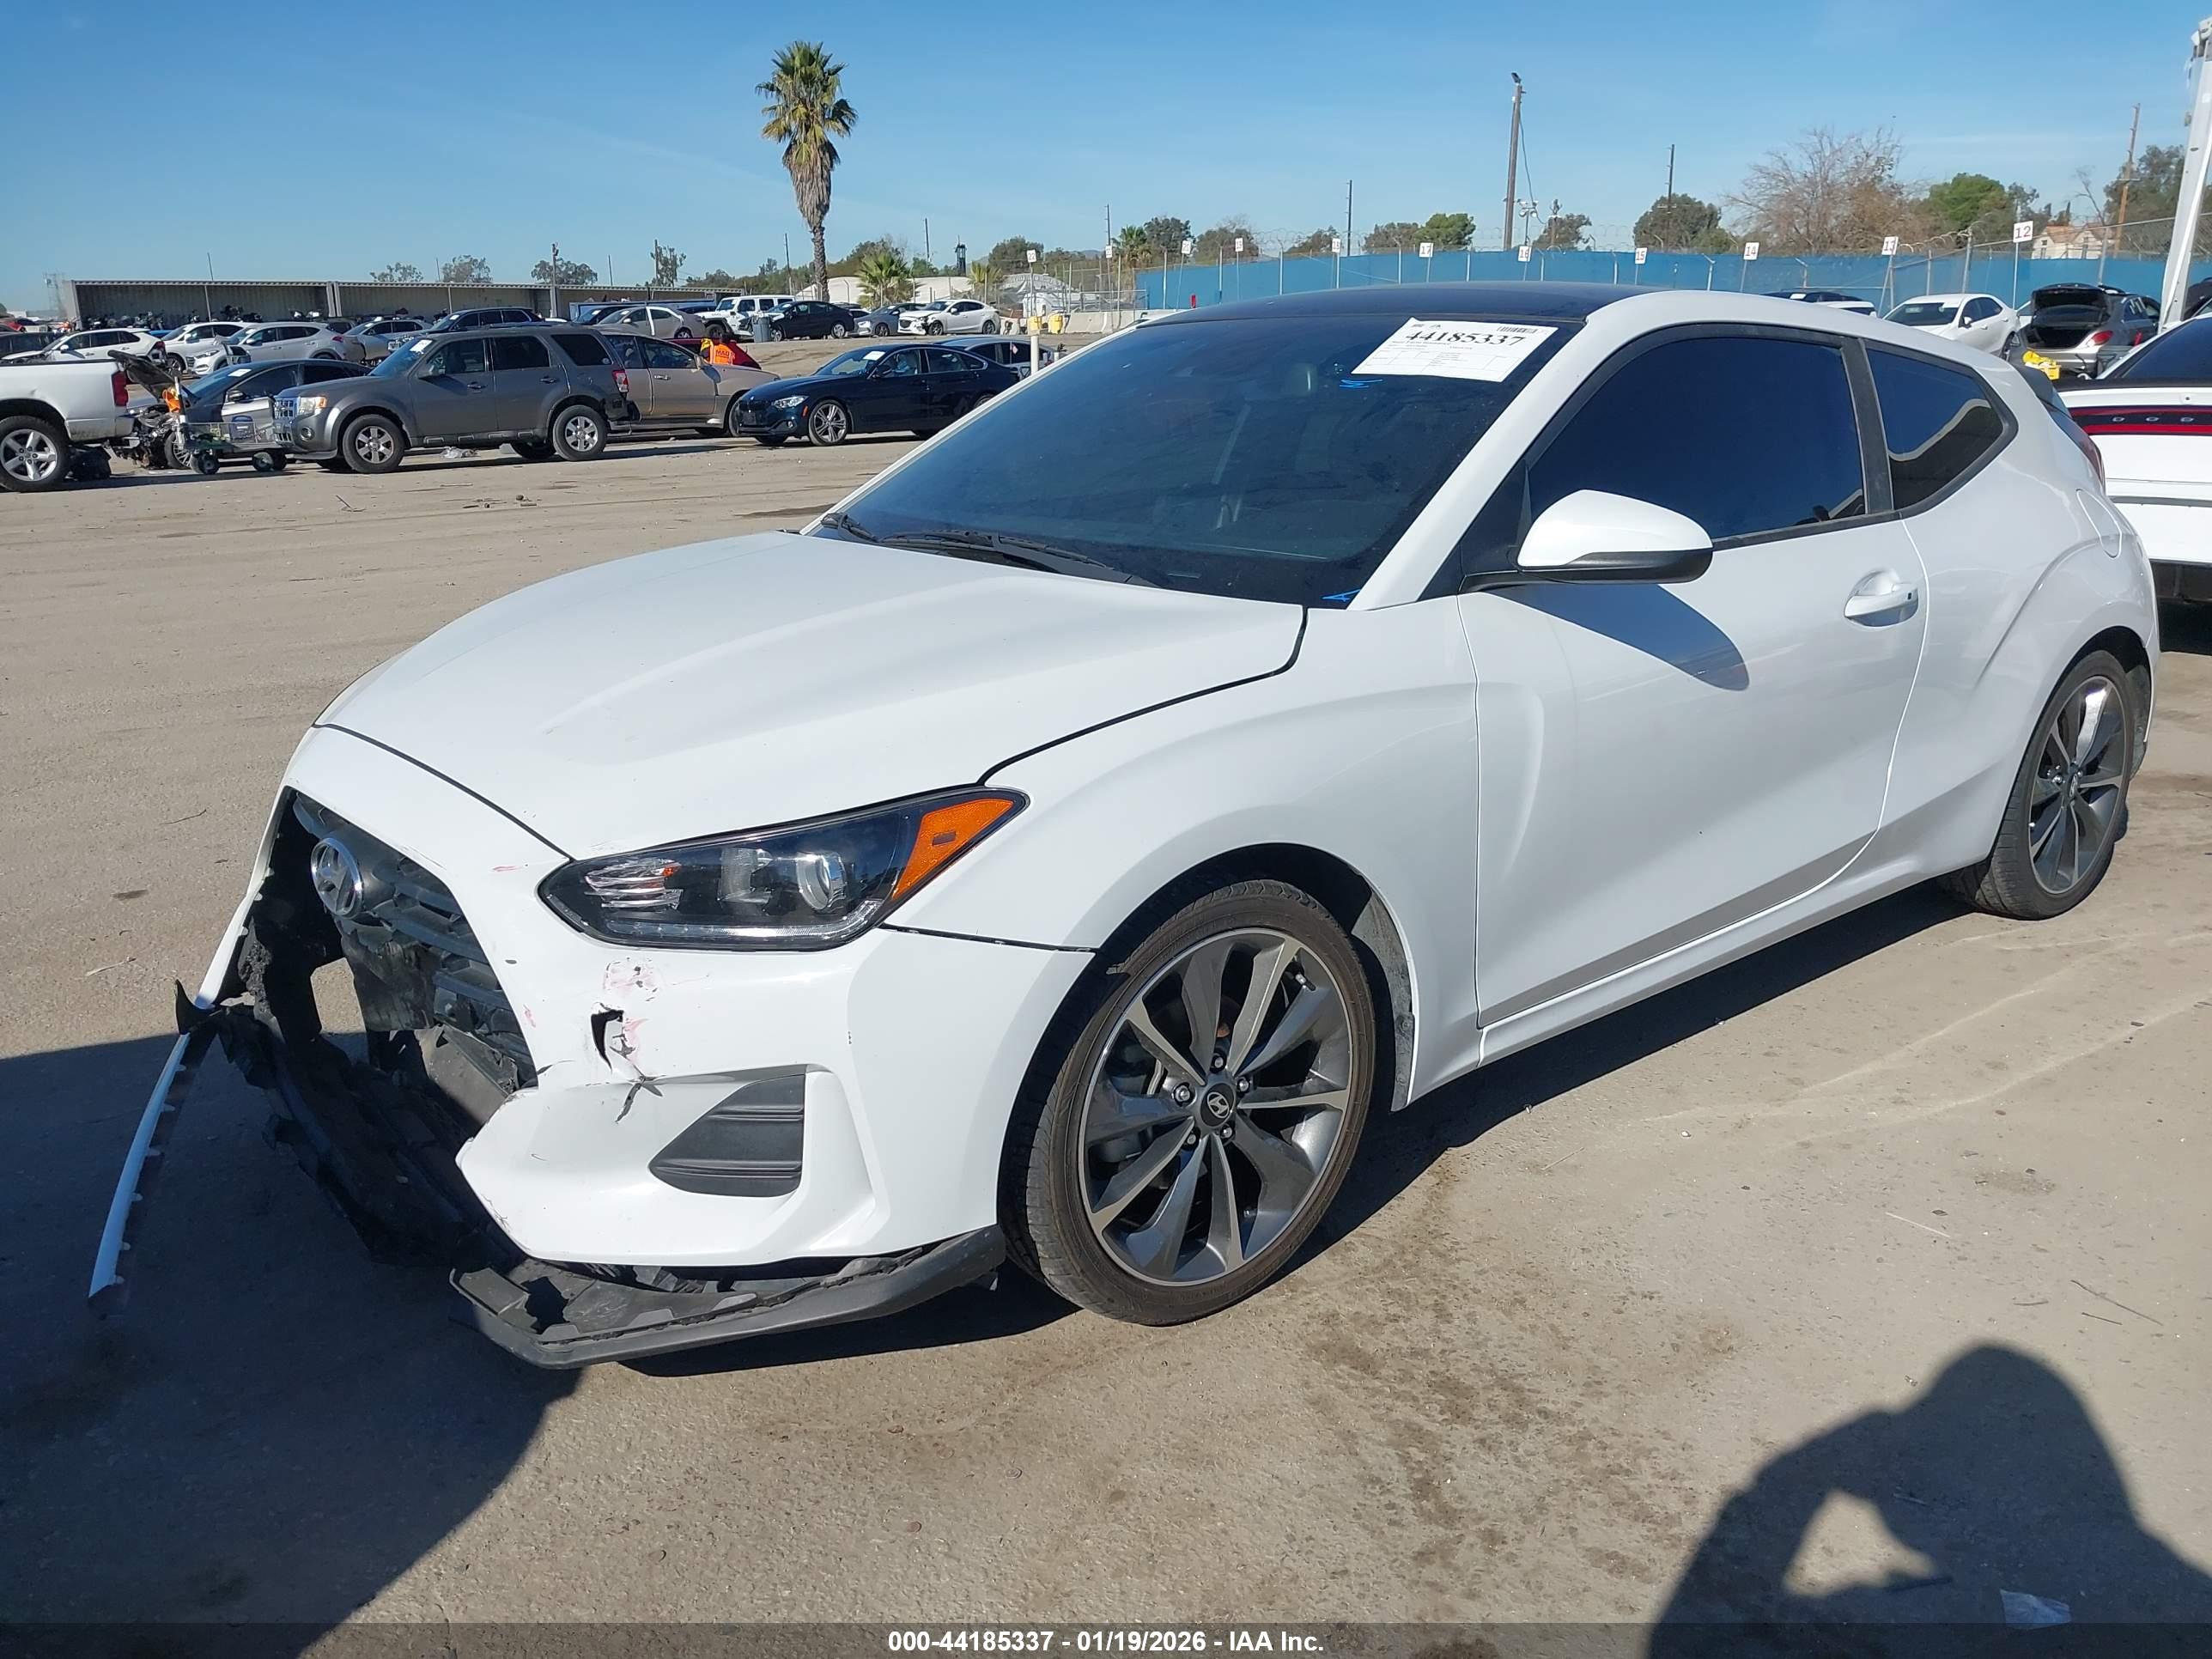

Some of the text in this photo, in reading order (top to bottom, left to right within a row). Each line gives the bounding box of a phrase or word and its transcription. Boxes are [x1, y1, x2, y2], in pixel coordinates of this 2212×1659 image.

[2014, 225, 2032, 240] 12
[1421, 246, 1431, 254] 17
[1746, 246, 1756, 257] 14
[1883, 240, 1896, 252] 13
[1636, 252, 1645, 261] 15
[1406, 331, 1526, 347] 44185337
